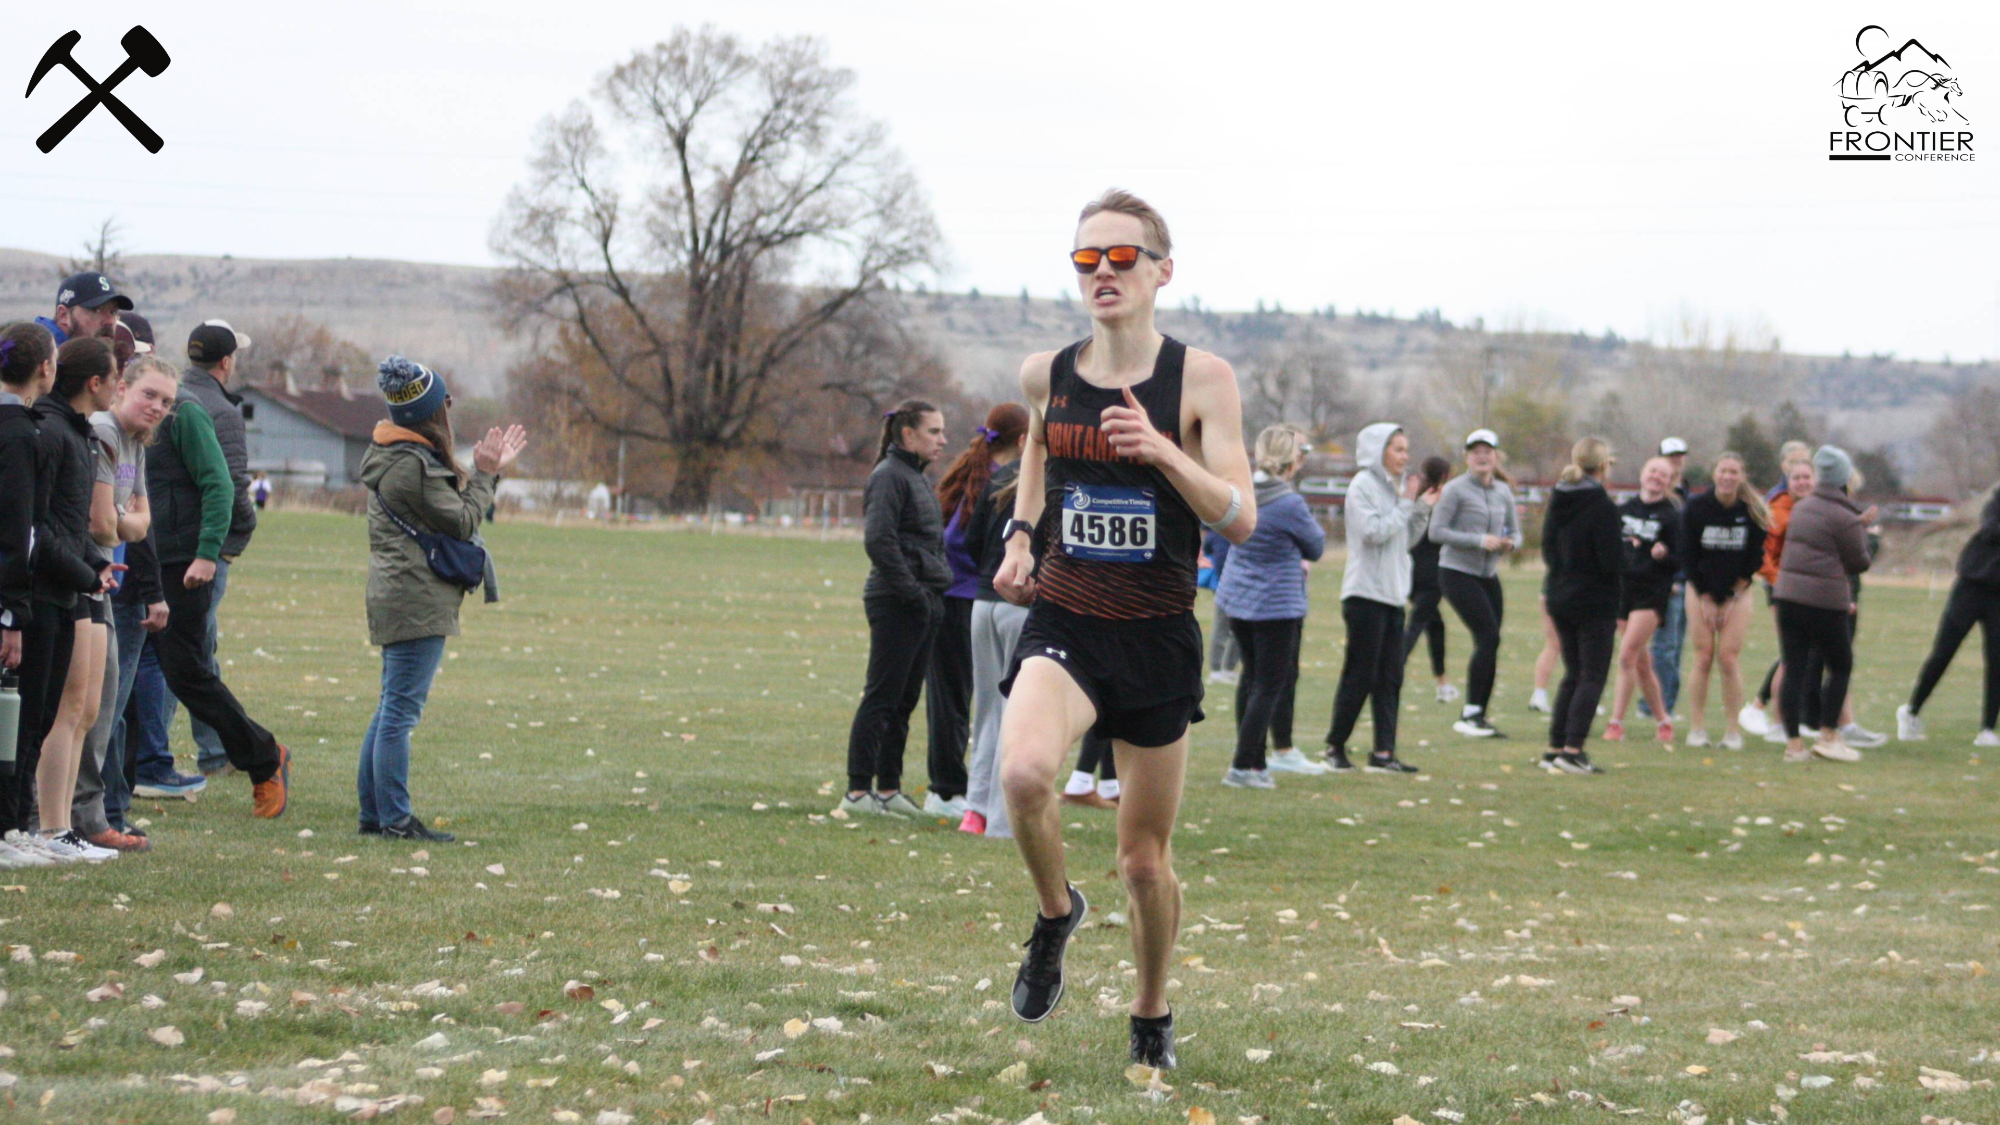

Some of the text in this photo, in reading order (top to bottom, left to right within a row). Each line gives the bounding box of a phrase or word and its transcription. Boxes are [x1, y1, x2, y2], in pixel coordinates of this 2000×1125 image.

[99, 276, 110, 291] S
[1092, 497, 1151, 507] Competitive Timing
[1070, 513, 1148, 547] 4586
